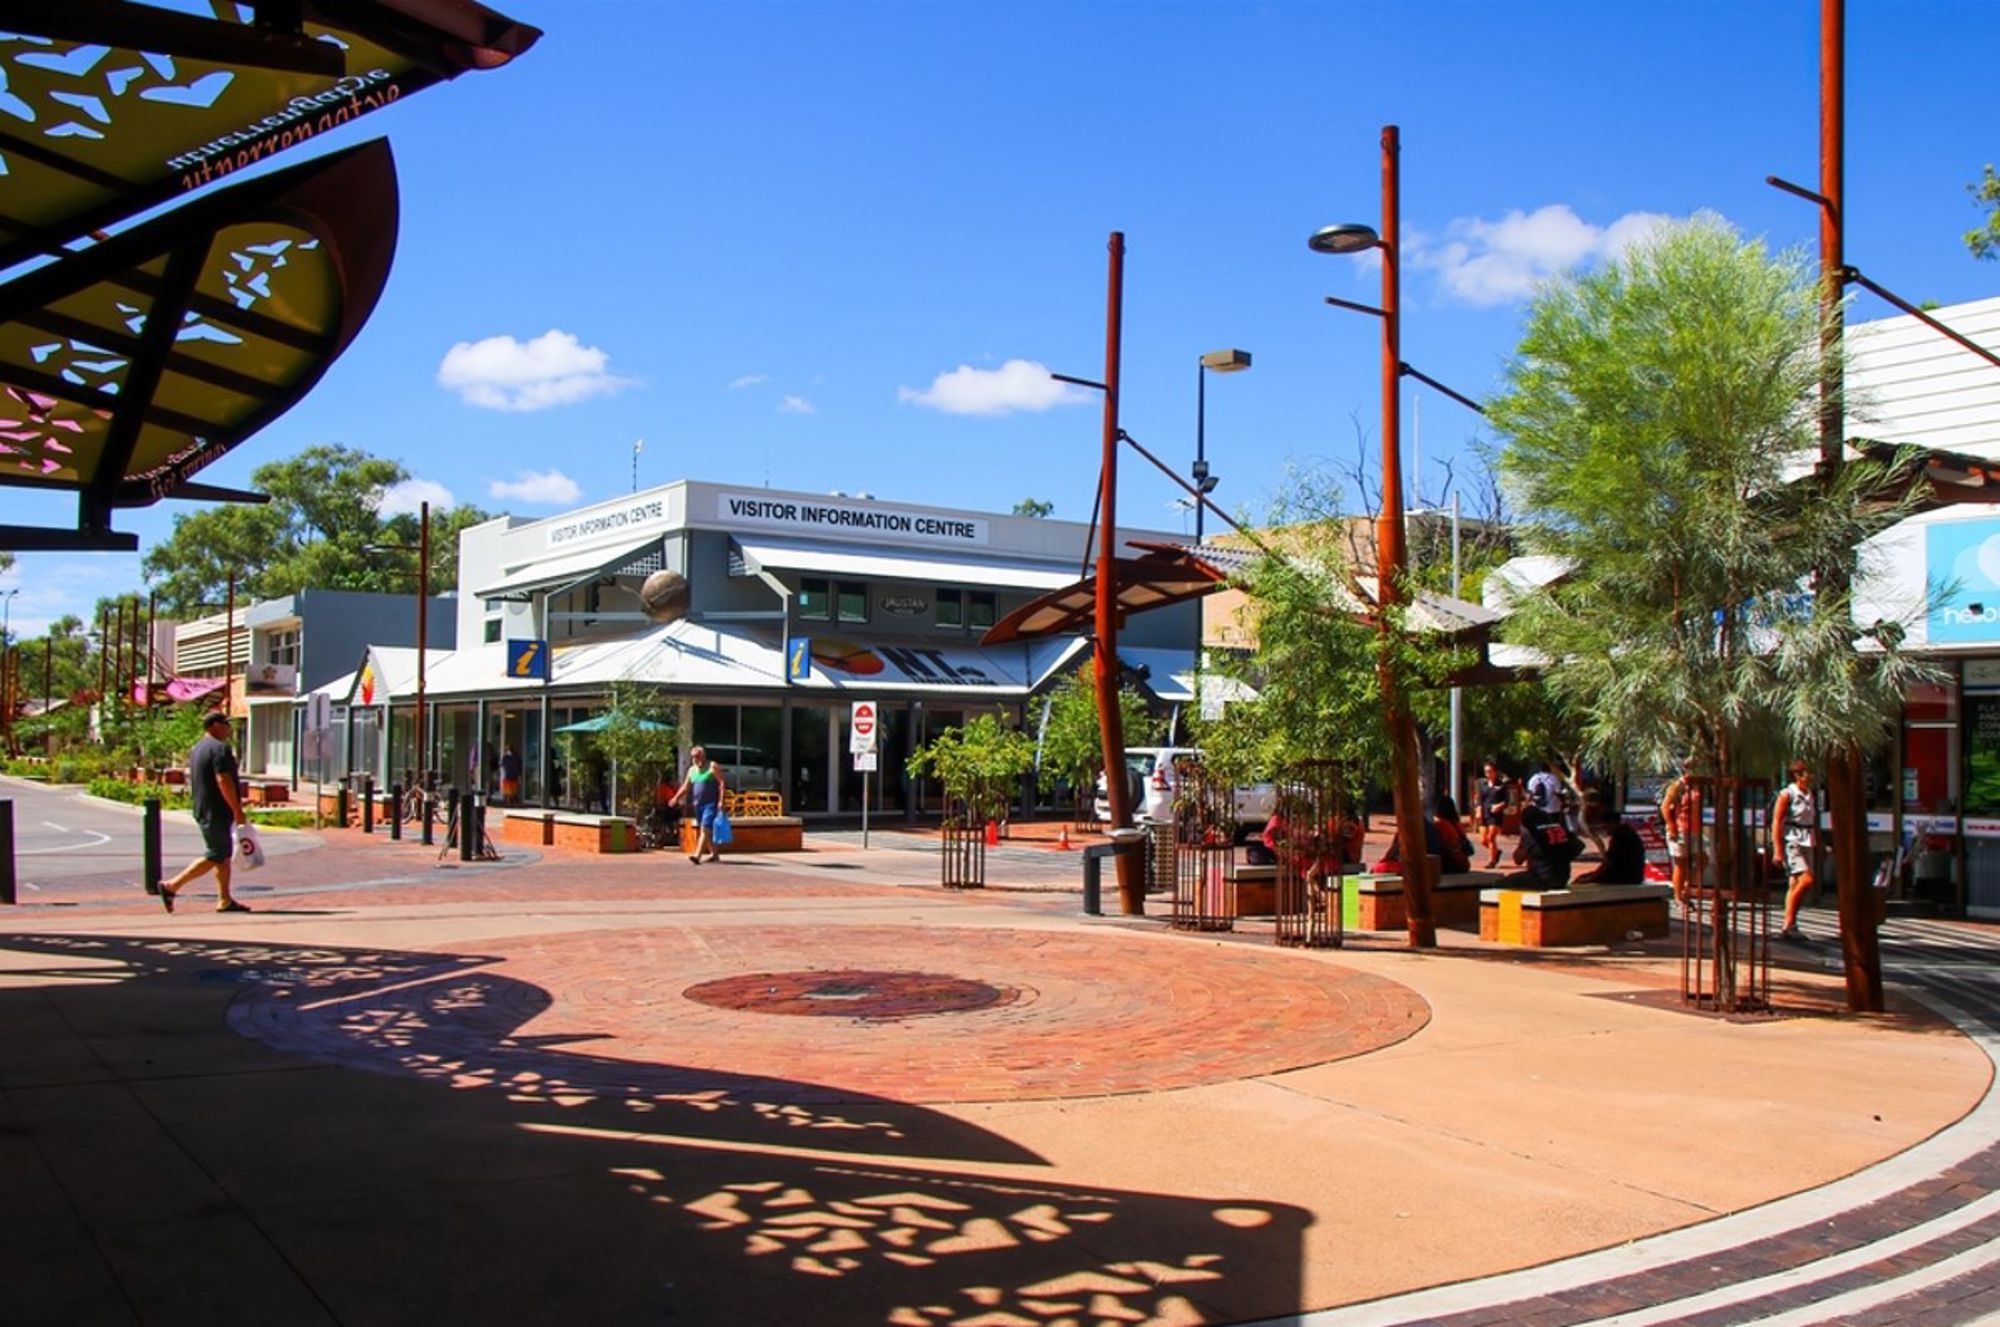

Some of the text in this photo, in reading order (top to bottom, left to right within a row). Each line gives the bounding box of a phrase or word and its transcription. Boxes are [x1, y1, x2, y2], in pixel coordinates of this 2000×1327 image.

[551, 501, 663, 543] VISITOR INFORMATION CENTRE
[730, 498, 975, 538] VISITOR INFORMATION CENTRE
